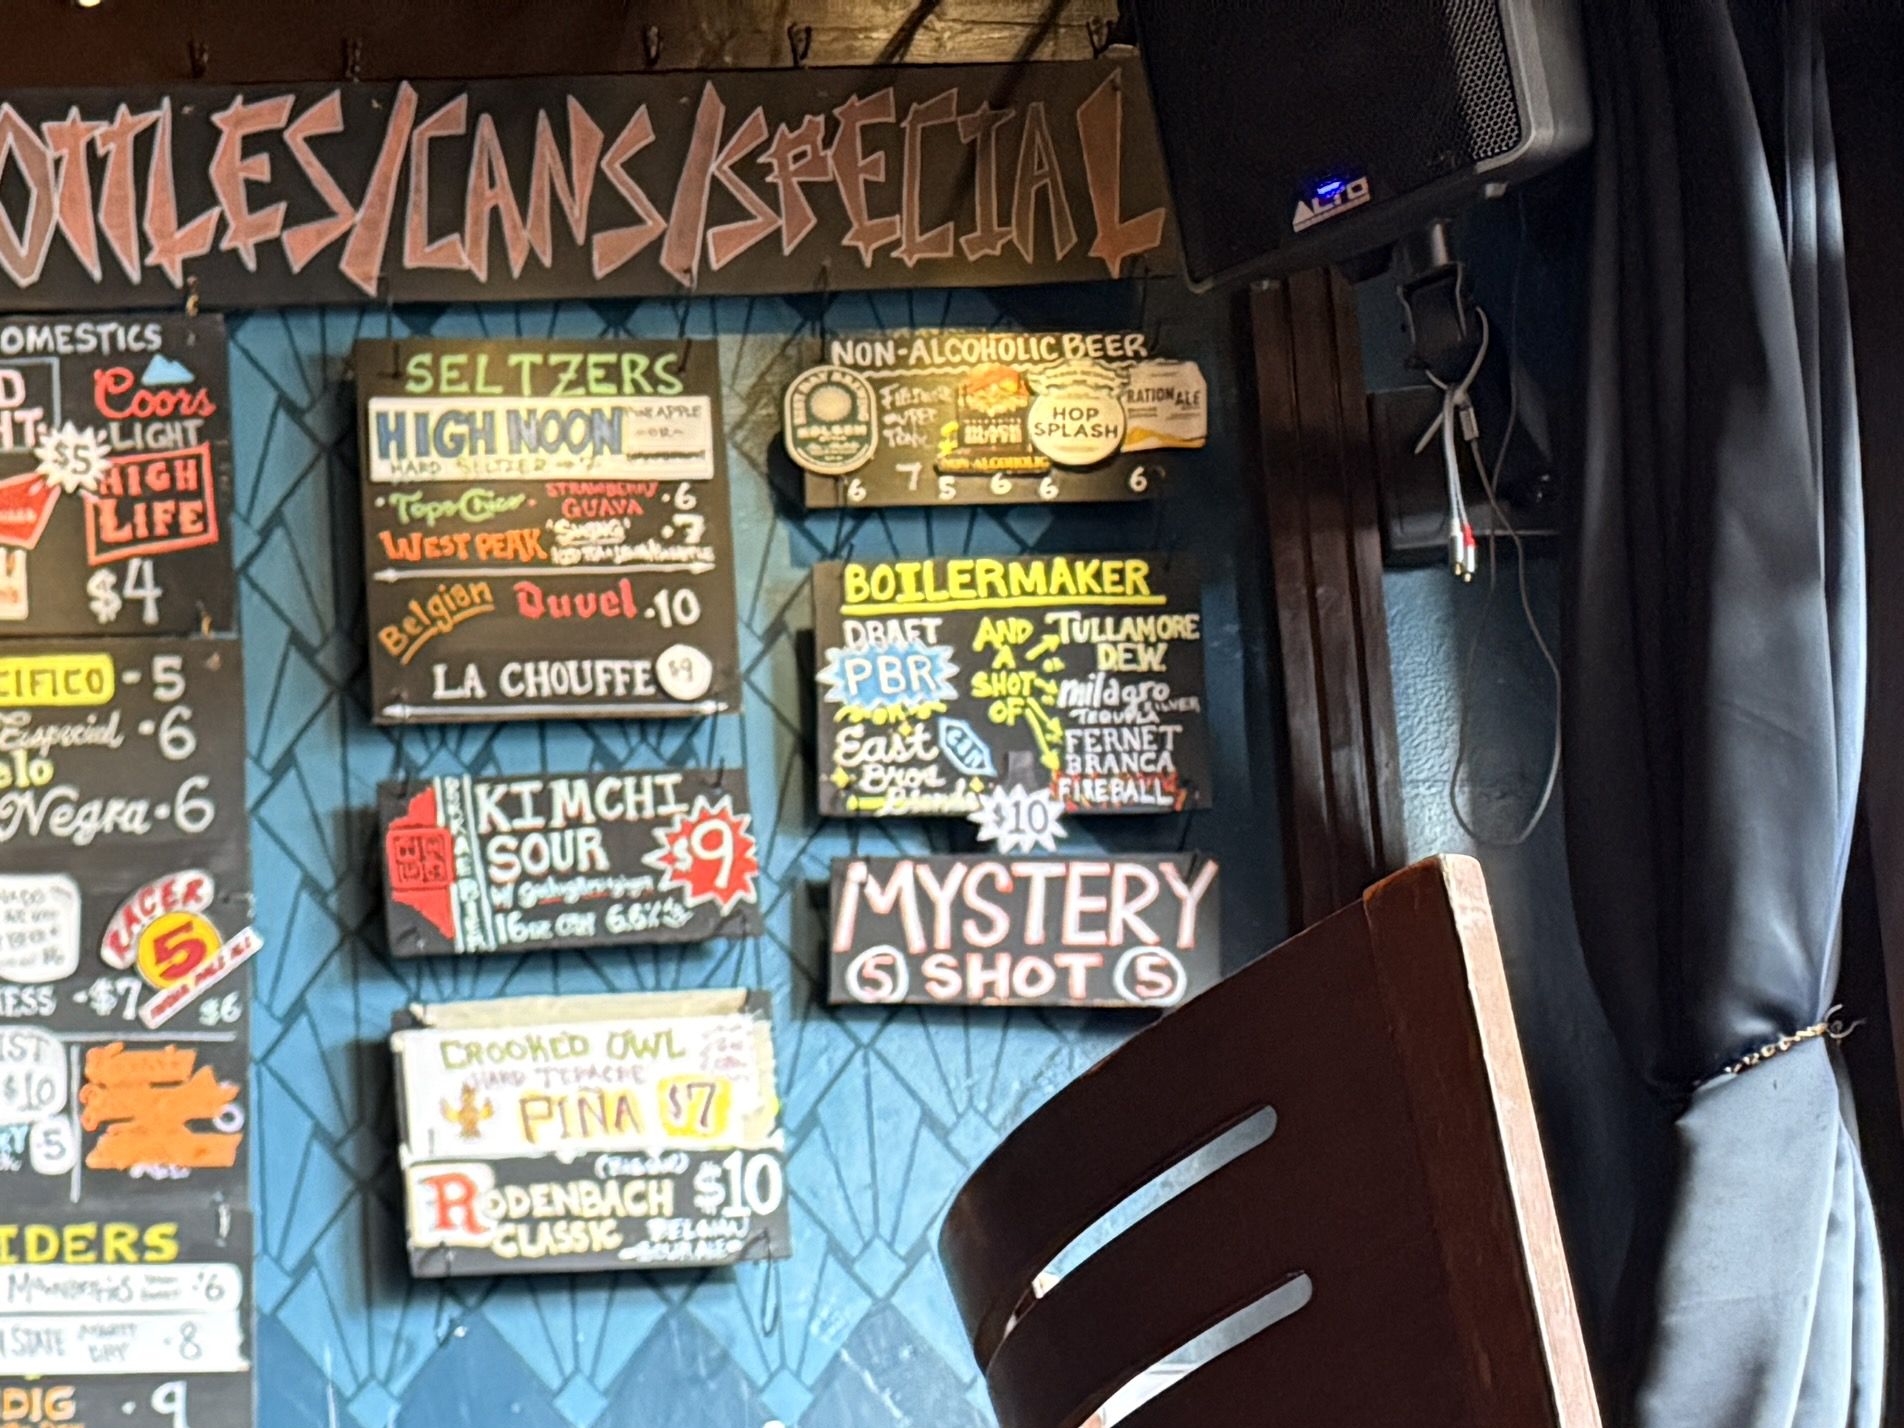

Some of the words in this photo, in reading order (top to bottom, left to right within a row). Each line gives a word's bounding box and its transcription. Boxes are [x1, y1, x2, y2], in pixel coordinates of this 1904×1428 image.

[830, 334, 1060, 367] NON-ALCOHOLIC
[1061, 333, 1149, 358] BEER
[92, 366, 217, 420] Coors
[404, 351, 685, 397] SELTZERS
[108, 418, 205, 451] LIGHT
[375, 409, 497, 460] HIGH
[506, 404, 625, 458] NOON
[1033, 422, 1120, 439] SPLASH
[1052, 406, 1100, 422] HOP
[52, 438, 95, 477] $5
[97, 458, 199, 498] HIGH
[455, 457, 546, 477] SELTZER
[98, 499, 207, 544] LIFE
[560, 498, 644, 520] GUAVA
[378, 531, 471, 562] WEST
[474, 529, 549, 563] PEAK
[85, 557, 164, 626] $4
[513, 577, 639, 620] Duvel
[843, 556, 1153, 604] BOILERMAKER
[378, 580, 496, 657] Belgian
[842, 617, 944, 649] DRAFT
[972, 616, 1035, 652] AND
[1045, 610, 1201, 645] TULLAMORE
[431, 662, 487, 700] LA
[499, 659, 657, 698] CHOUFFE
[845, 653, 938, 698] PBR
[971, 670, 1037, 698] SHOT
[988, 699, 1026, 726] OF
[833, 722, 940, 768] East
[1065, 725, 1184, 753] FERNET
[1065, 751, 1175, 777] BRANCA
[475, 773, 690, 834] KIMCHI
[1058, 778, 1175, 806] FIREBALL
[992, 799, 1049, 835] $10
[487, 827, 611, 885] SOUR
[667, 816, 735, 890] $9
[108, 878, 206, 962] RACER
[832, 859, 1219, 955] MYSTERY
[153, 919, 208, 980] 5
[920, 952, 1104, 1000] SHOT
[440, 1032, 591, 1069] CROOKED
[606, 1030, 687, 1060] OWL
[518, 1086, 643, 1144] PIÑA
[420, 1171, 675, 1236] RODENBACH
[693, 1150, 783, 1218] $10
[493, 1218, 624, 1259] CLASSIC
